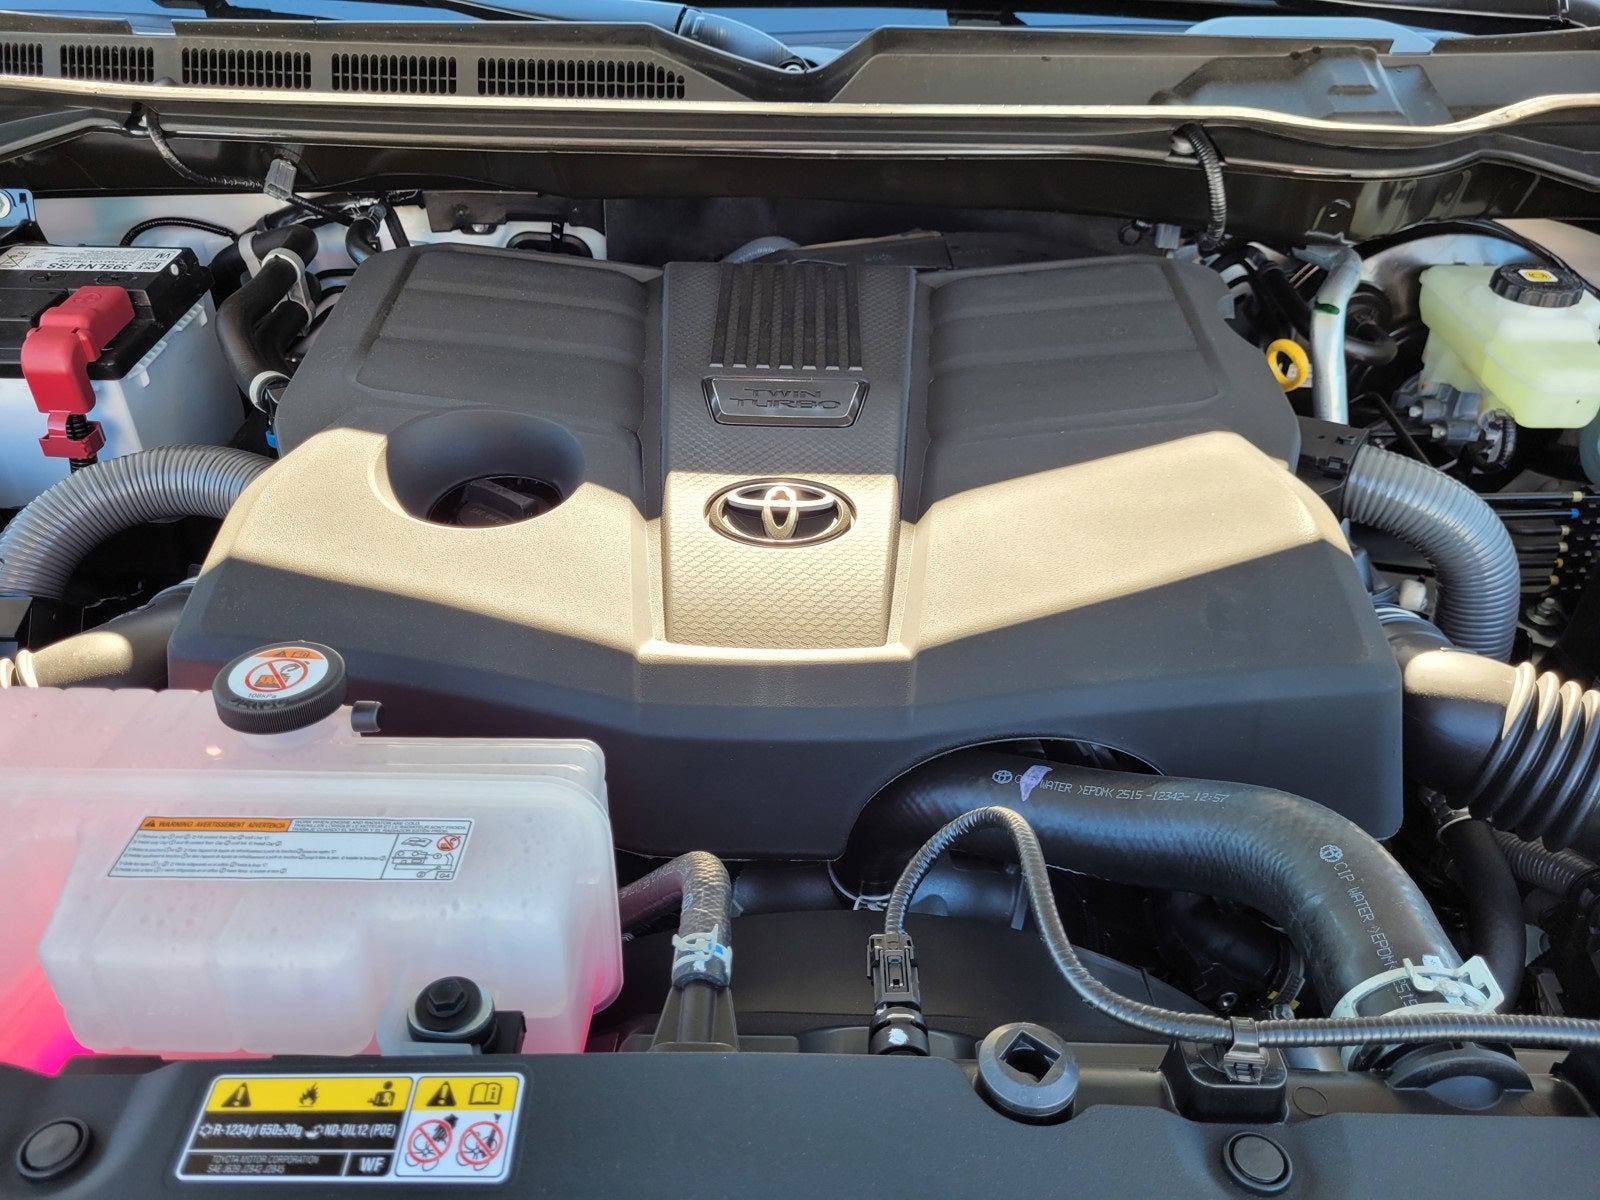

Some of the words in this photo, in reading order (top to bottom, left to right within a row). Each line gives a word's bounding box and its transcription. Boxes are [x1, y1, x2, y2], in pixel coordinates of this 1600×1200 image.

[744, 388, 821, 398] TWIN
[729, 397, 841, 409] TURBO
[1040, 780, 1073, 793] WATER
[1115, 789, 1144, 800] 2515
[1194, 792, 1230, 803] 12:57
[1333, 862, 1355, 882] CIP
[1347, 886, 1375, 923] WATER
[213, 1123, 259, 1139] R-1234yf
[260, 1123, 304, 1139] 650±30g
[370, 1123, 396, 1139] (POE)
[359, 1156, 386, 1174] WF
